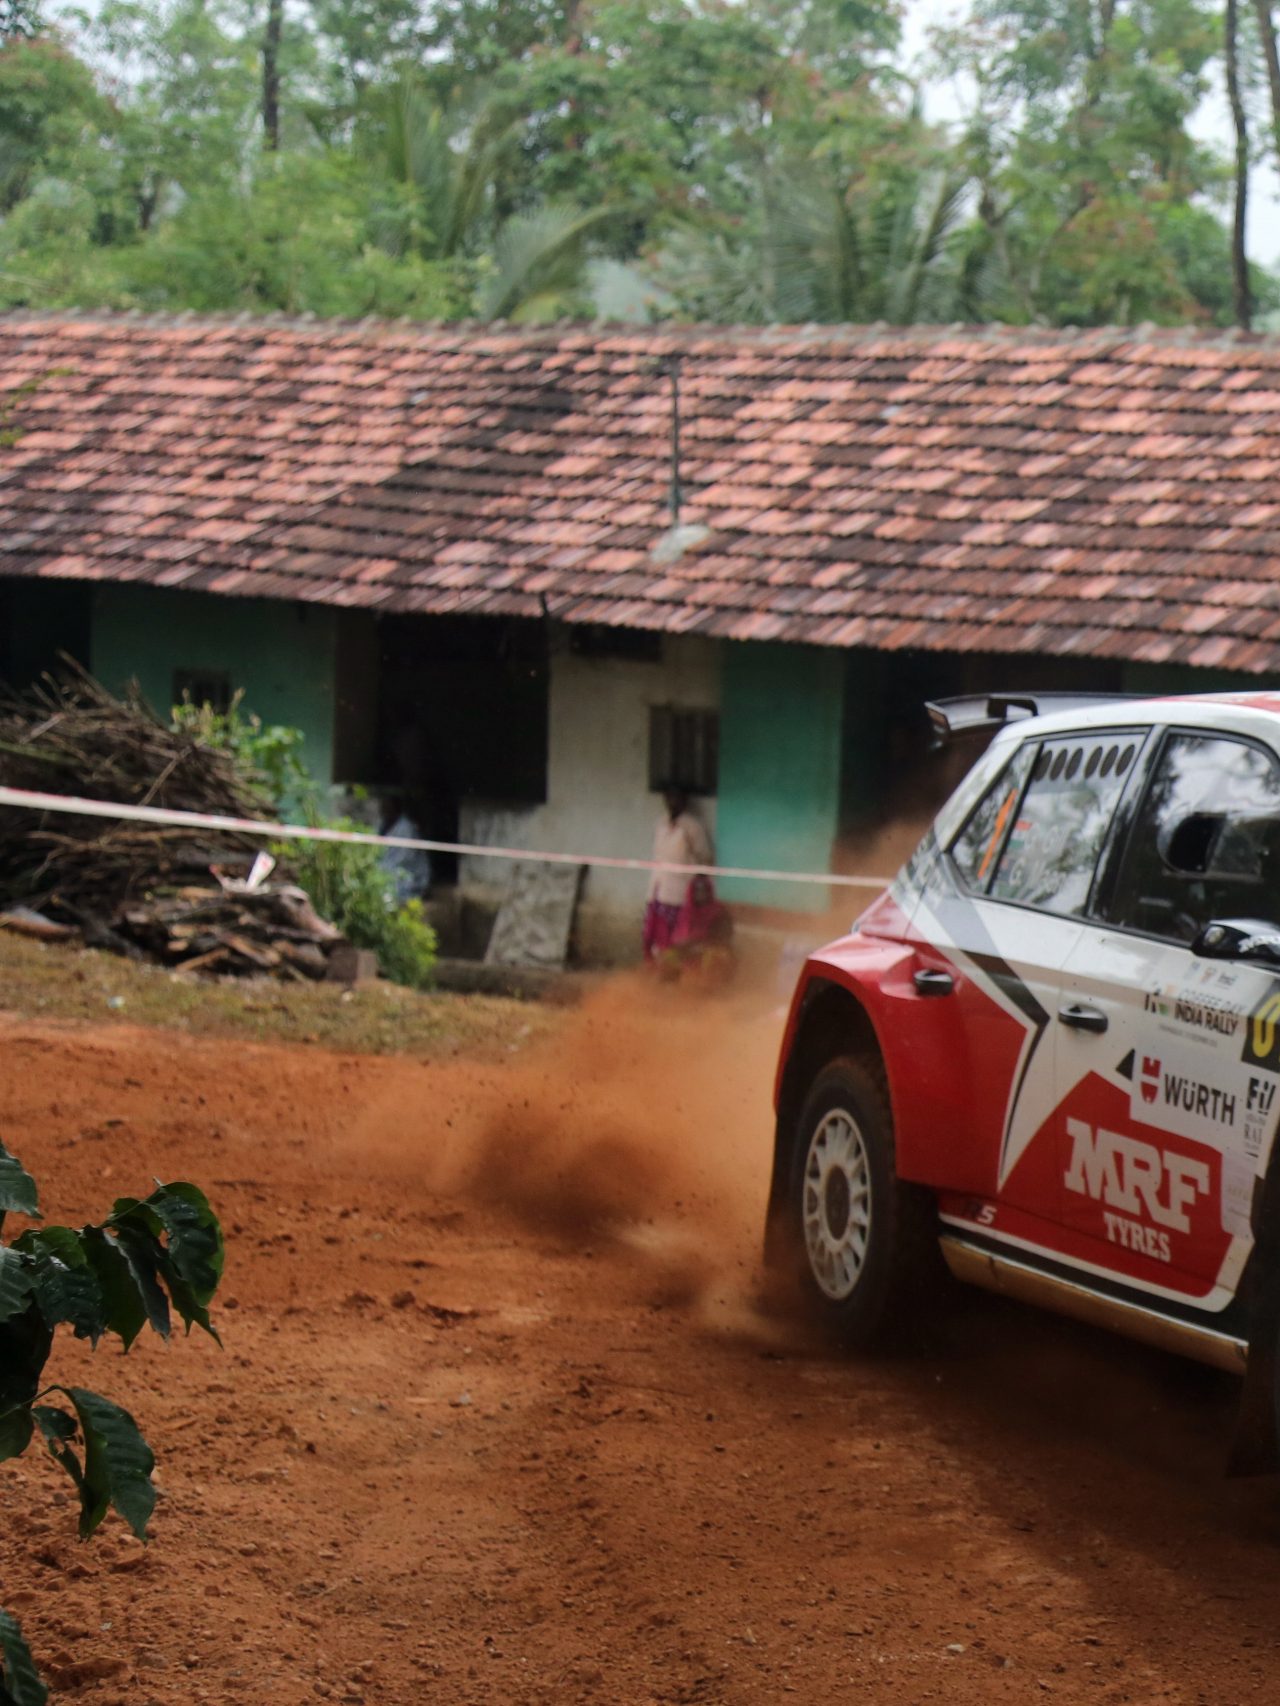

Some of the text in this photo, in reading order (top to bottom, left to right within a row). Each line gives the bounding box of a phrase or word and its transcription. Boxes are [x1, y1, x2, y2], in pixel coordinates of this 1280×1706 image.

[1204, 1008, 1239, 1036] RALLY
[1064, 1117, 1210, 1235] MRF
[1104, 1211, 1171, 1263] TYRES
